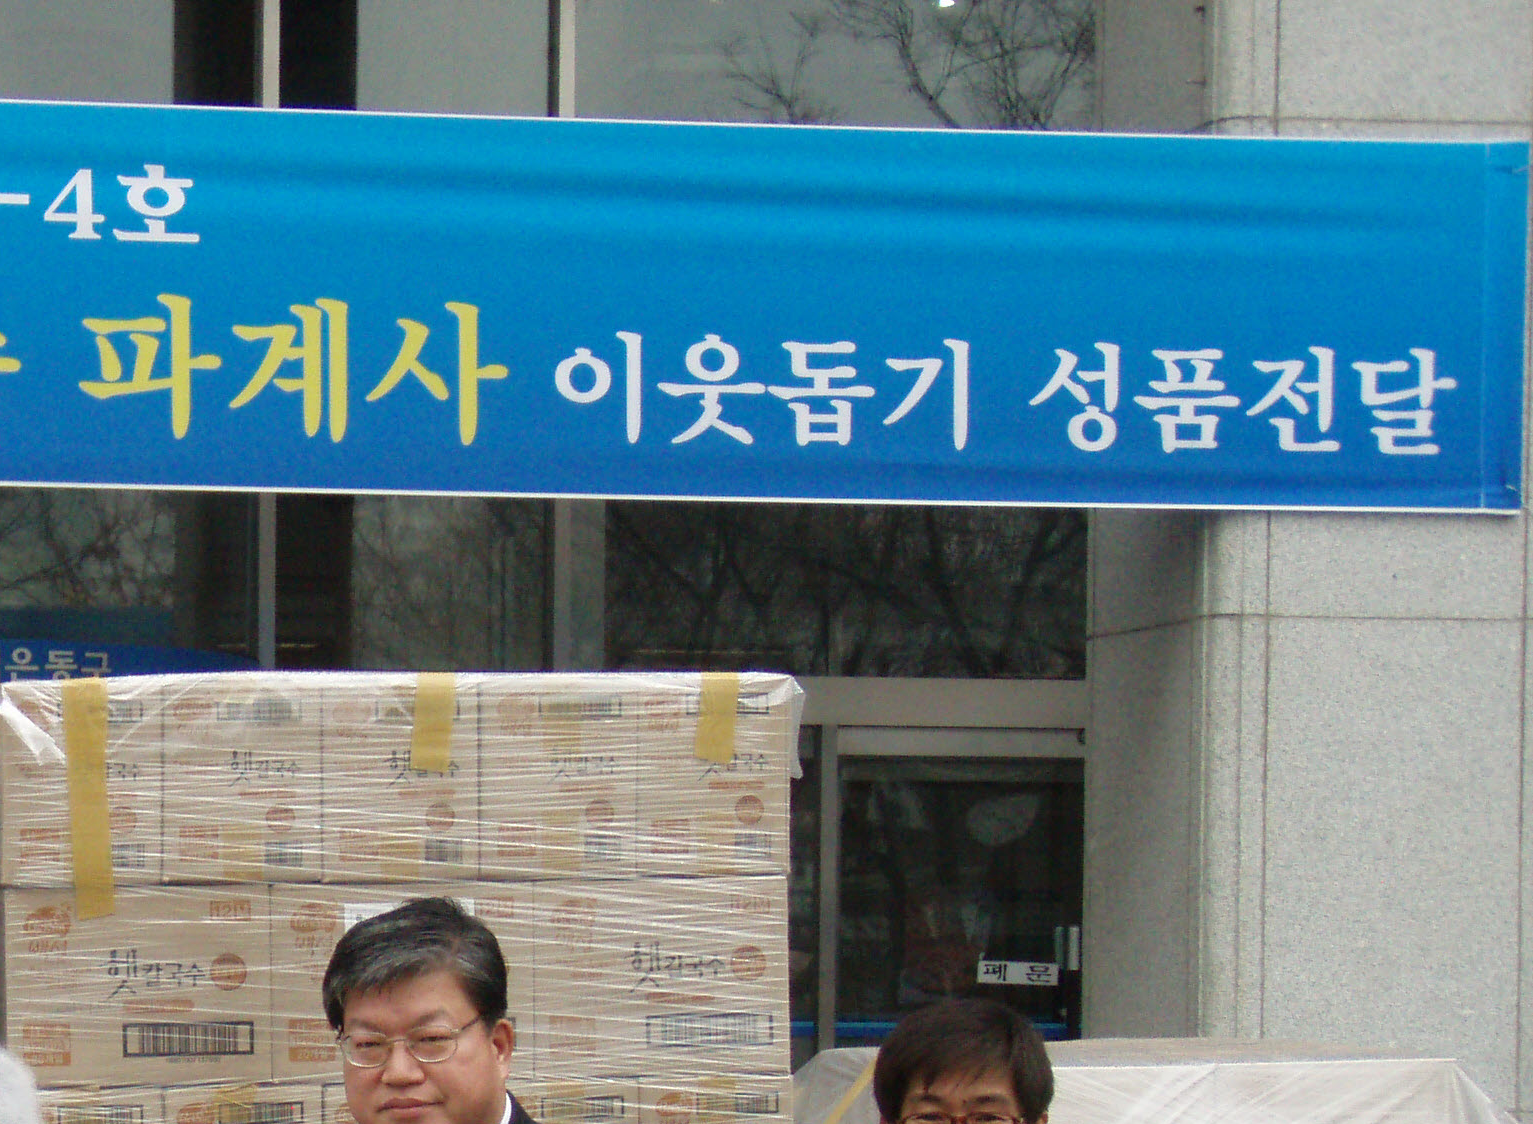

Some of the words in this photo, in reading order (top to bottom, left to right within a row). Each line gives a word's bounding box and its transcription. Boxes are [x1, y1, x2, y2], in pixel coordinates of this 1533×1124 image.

[78, 292, 509, 447] 파계사
[554, 330, 970, 451] 이웃돕기
[1029, 341, 1459, 456] 성품전달
[101, 949, 208, 999] 햇칼국수
